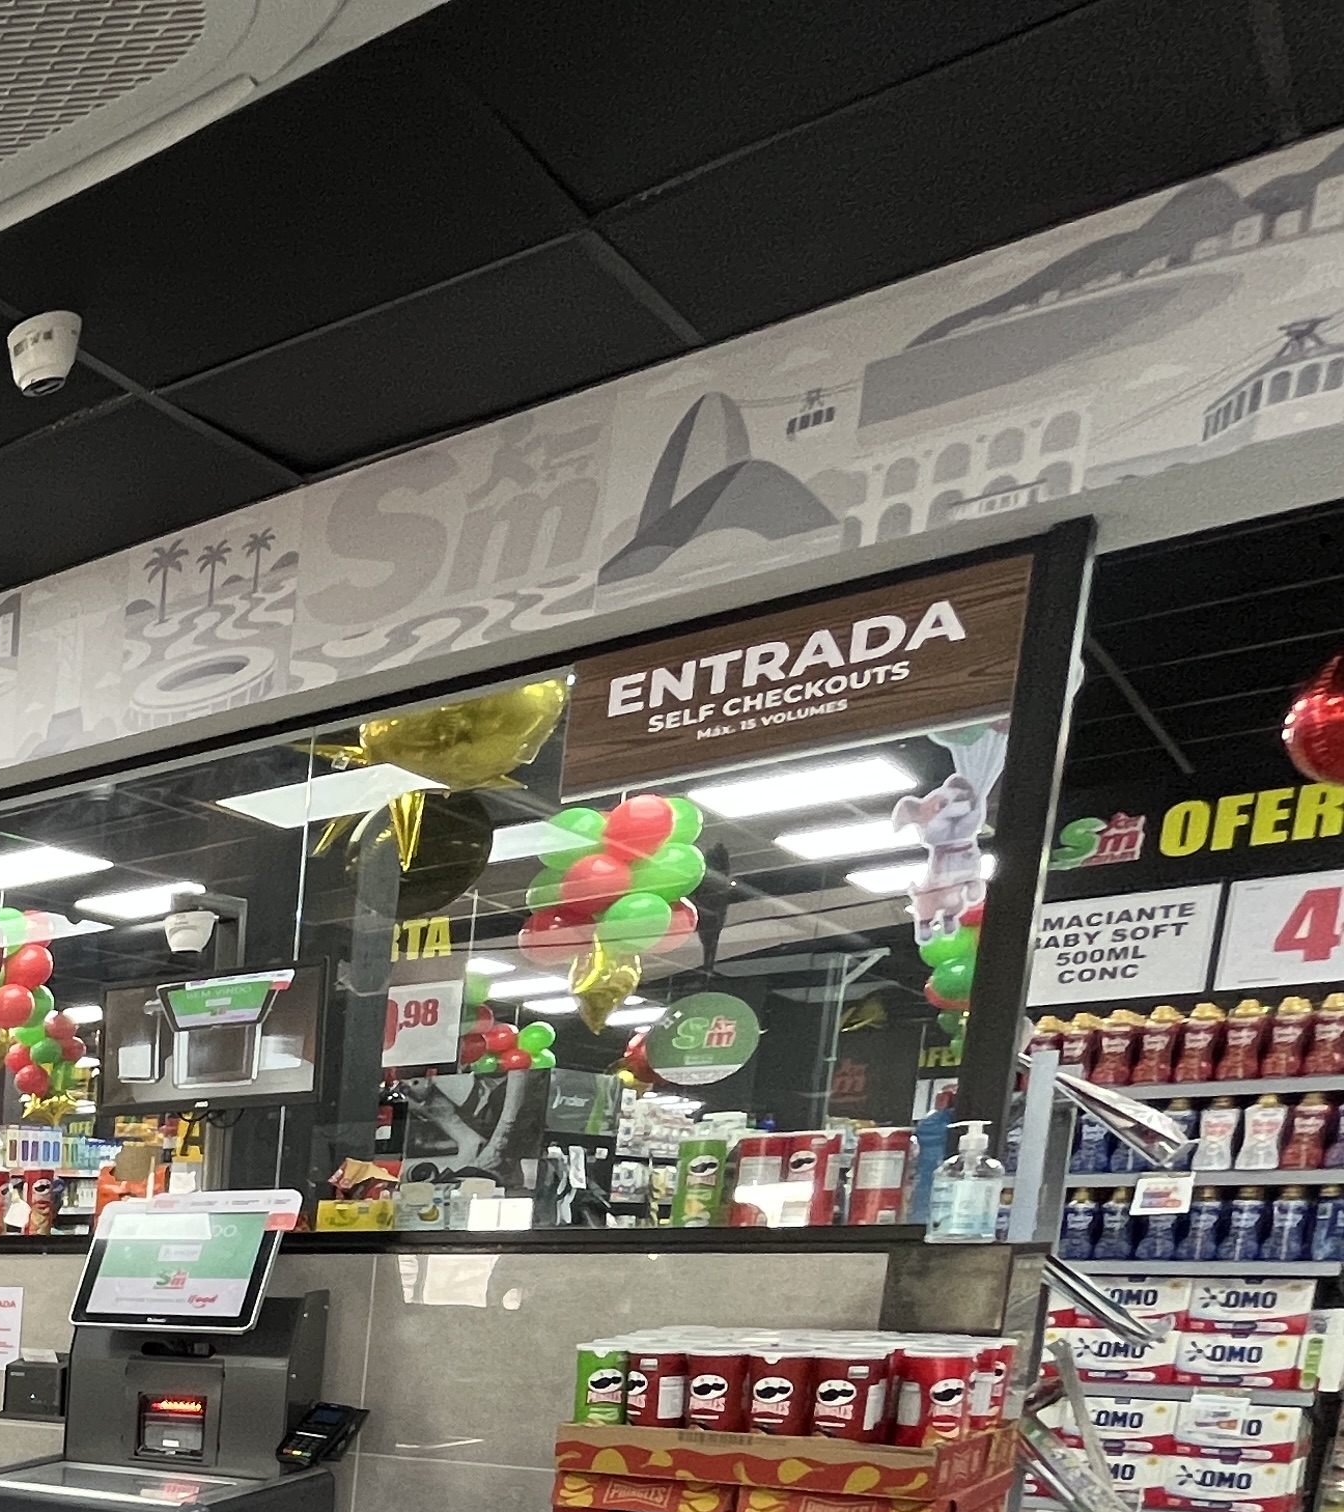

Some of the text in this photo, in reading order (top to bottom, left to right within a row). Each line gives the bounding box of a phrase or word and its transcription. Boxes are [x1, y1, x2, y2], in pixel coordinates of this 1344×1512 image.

[606, 601, 968, 719] ENTRADA
[647, 660, 911, 734] SELF CHECKOUTS
[696, 699, 848, 741] Máx. 15 VOLUMES
[1111, 921, 1189, 944] SOFT
[1056, 945, 1148, 967] 500ML
[1058, 964, 1139, 985] CONC
[1112, 1288, 1158, 1306] OMO
[1223, 1289, 1277, 1309] OMO
[1097, 1340, 1145, 1358] OMO
[1211, 1344, 1263, 1363] OMO
[1095, 1410, 1143, 1428] OMO
[1107, 1463, 1135, 1481] MO
[1199, 1470, 1252, 1490] OMO
[611, 1482, 667, 1506] PRINGLES
